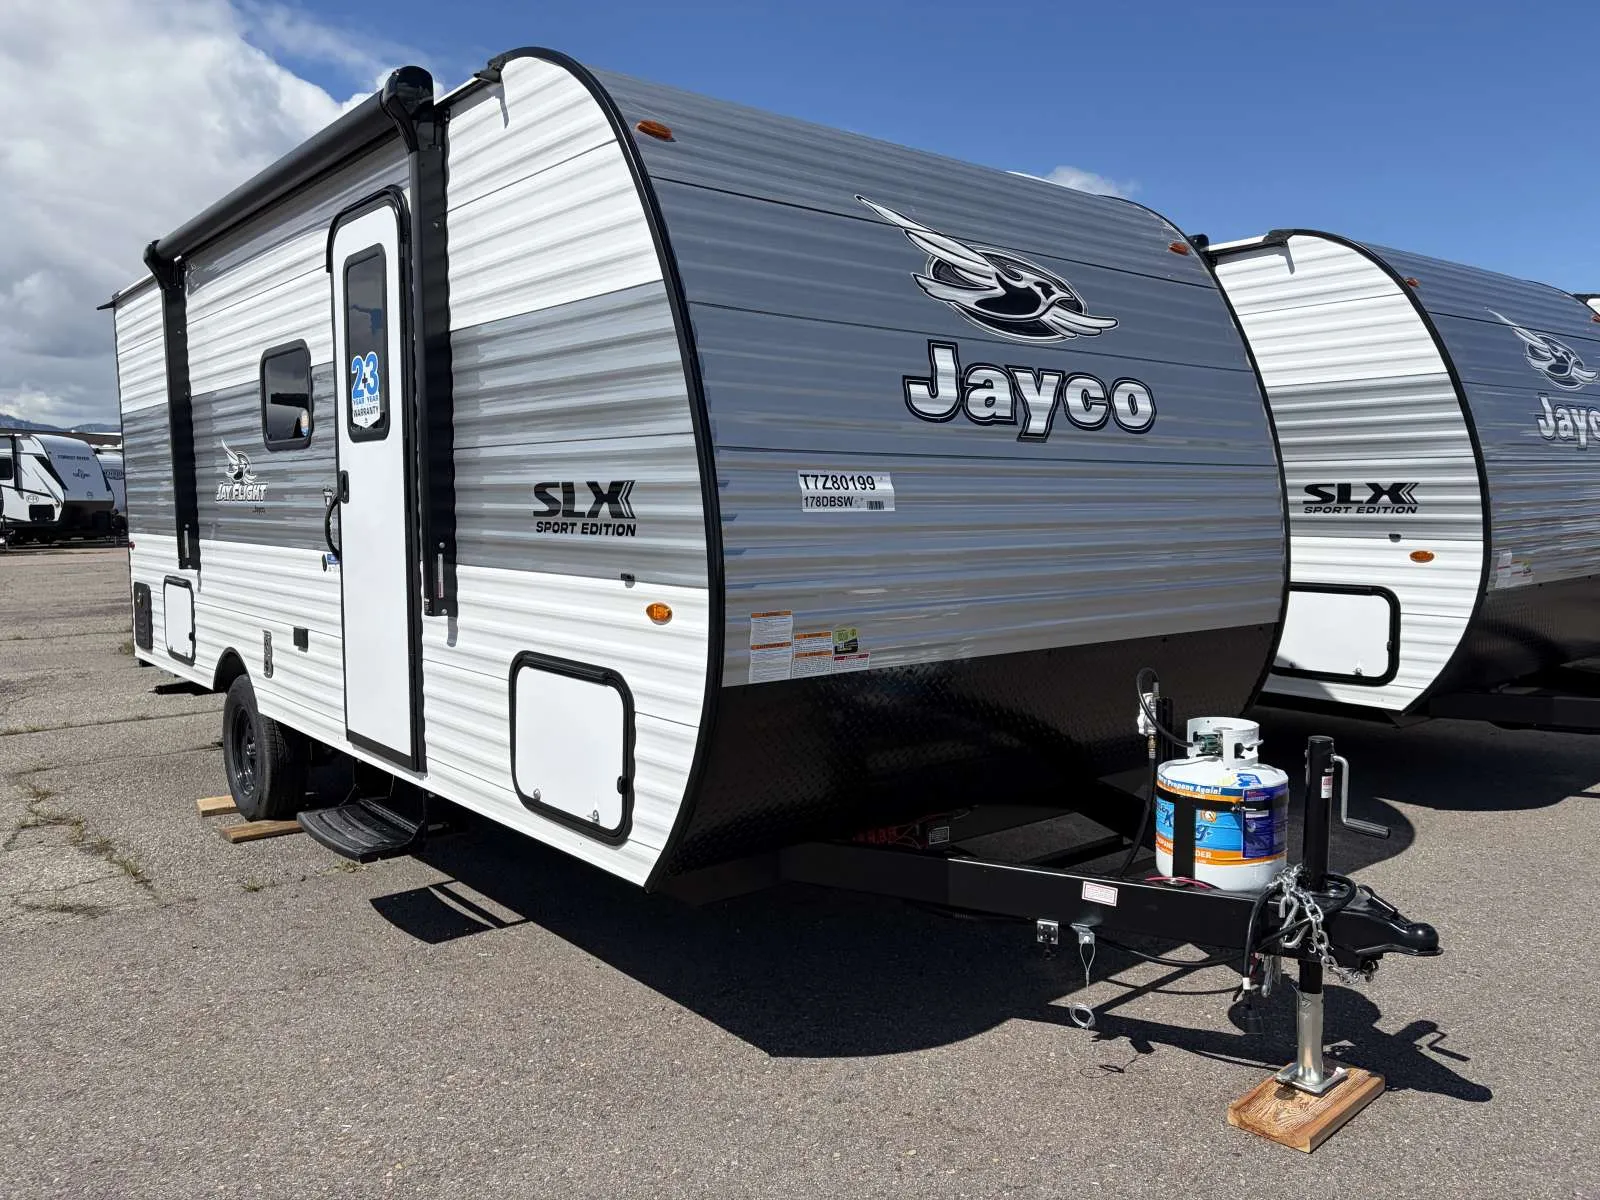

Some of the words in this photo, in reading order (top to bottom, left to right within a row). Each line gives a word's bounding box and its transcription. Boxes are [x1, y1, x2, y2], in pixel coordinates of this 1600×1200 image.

[903, 339, 1157, 442] Jayco
[354, 406, 379, 417] WARRANTY
[1535, 392, 1600, 450] Jayc
[799, 474, 876, 490] T7Z80199
[216, 481, 234, 501] JAY
[232, 482, 268, 501] FLIGHT
[1302, 482, 1419, 504] SLX
[533, 480, 636, 519] SLX
[804, 496, 854, 508] 178DBSW
[1303, 506, 1352, 514] SPORT
[1356, 506, 1419, 514] EDITION
[536, 521, 577, 534] SPORT
[581, 522, 637, 537] EDITION
[1167, 780, 1195, 792] Propane
[1196, 785, 1222, 795] Again!
